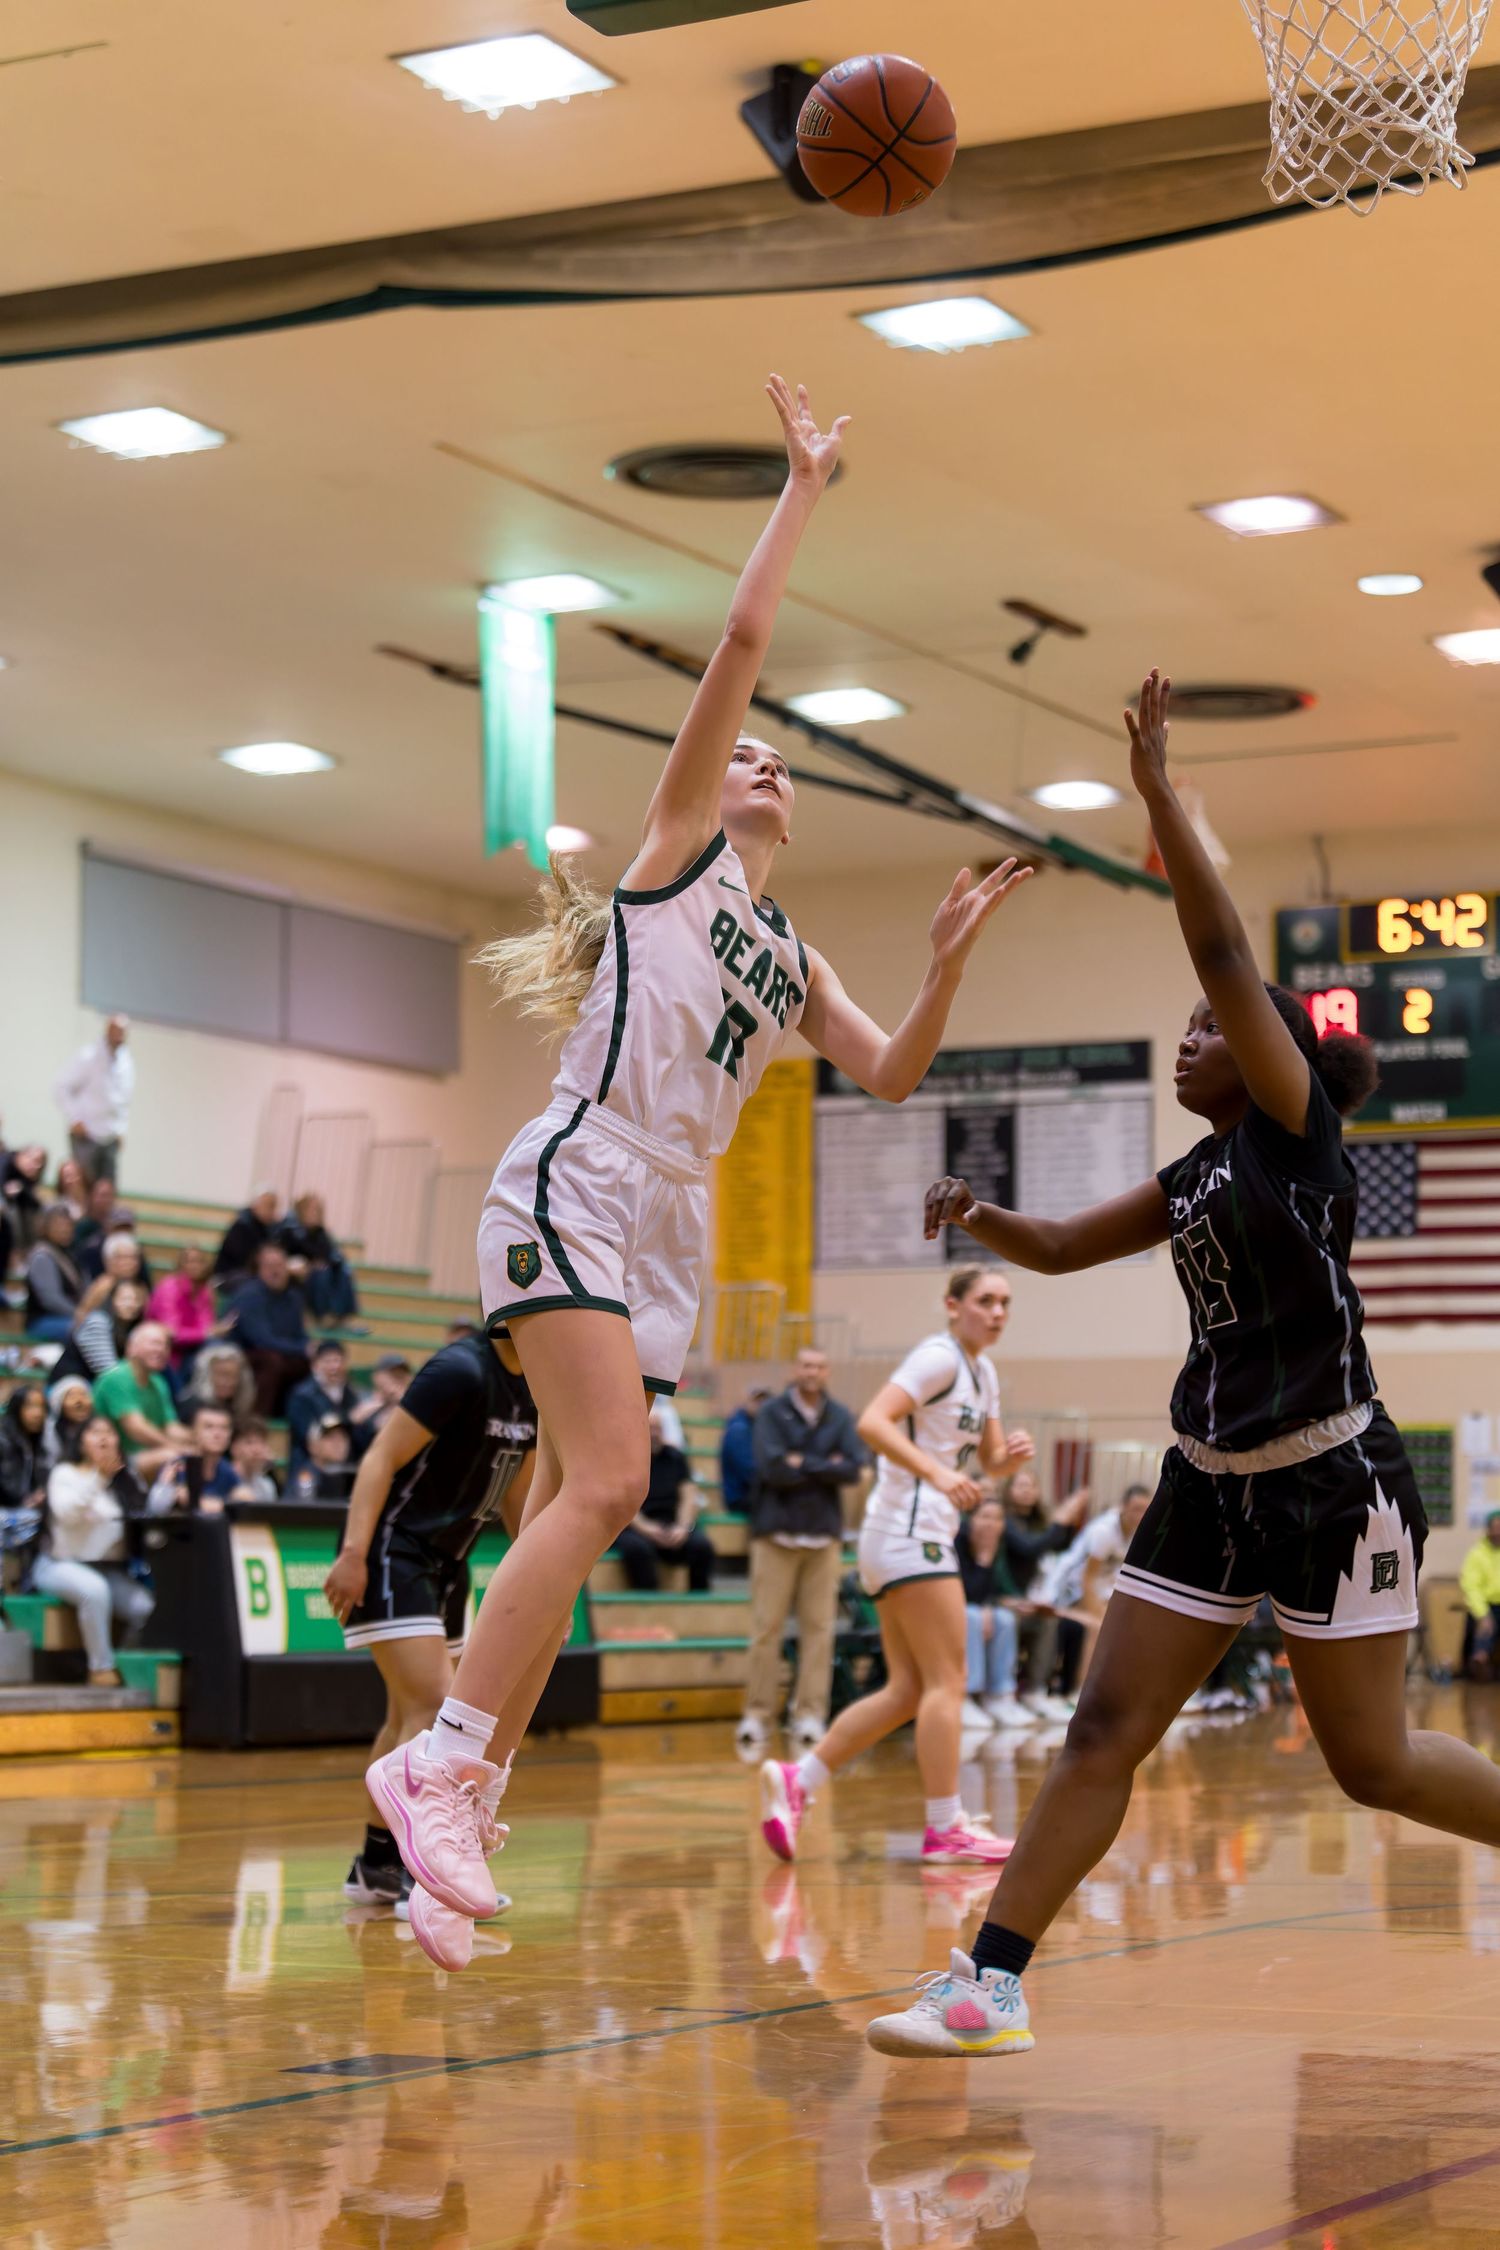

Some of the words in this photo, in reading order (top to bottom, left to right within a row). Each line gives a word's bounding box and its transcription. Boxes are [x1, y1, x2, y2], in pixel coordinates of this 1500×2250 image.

[1377, 893, 1488, 954] 6:42
[709, 908, 804, 1030] BEARS
[1402, 987, 1434, 1034] 2
[243, 1556, 272, 1617] B
